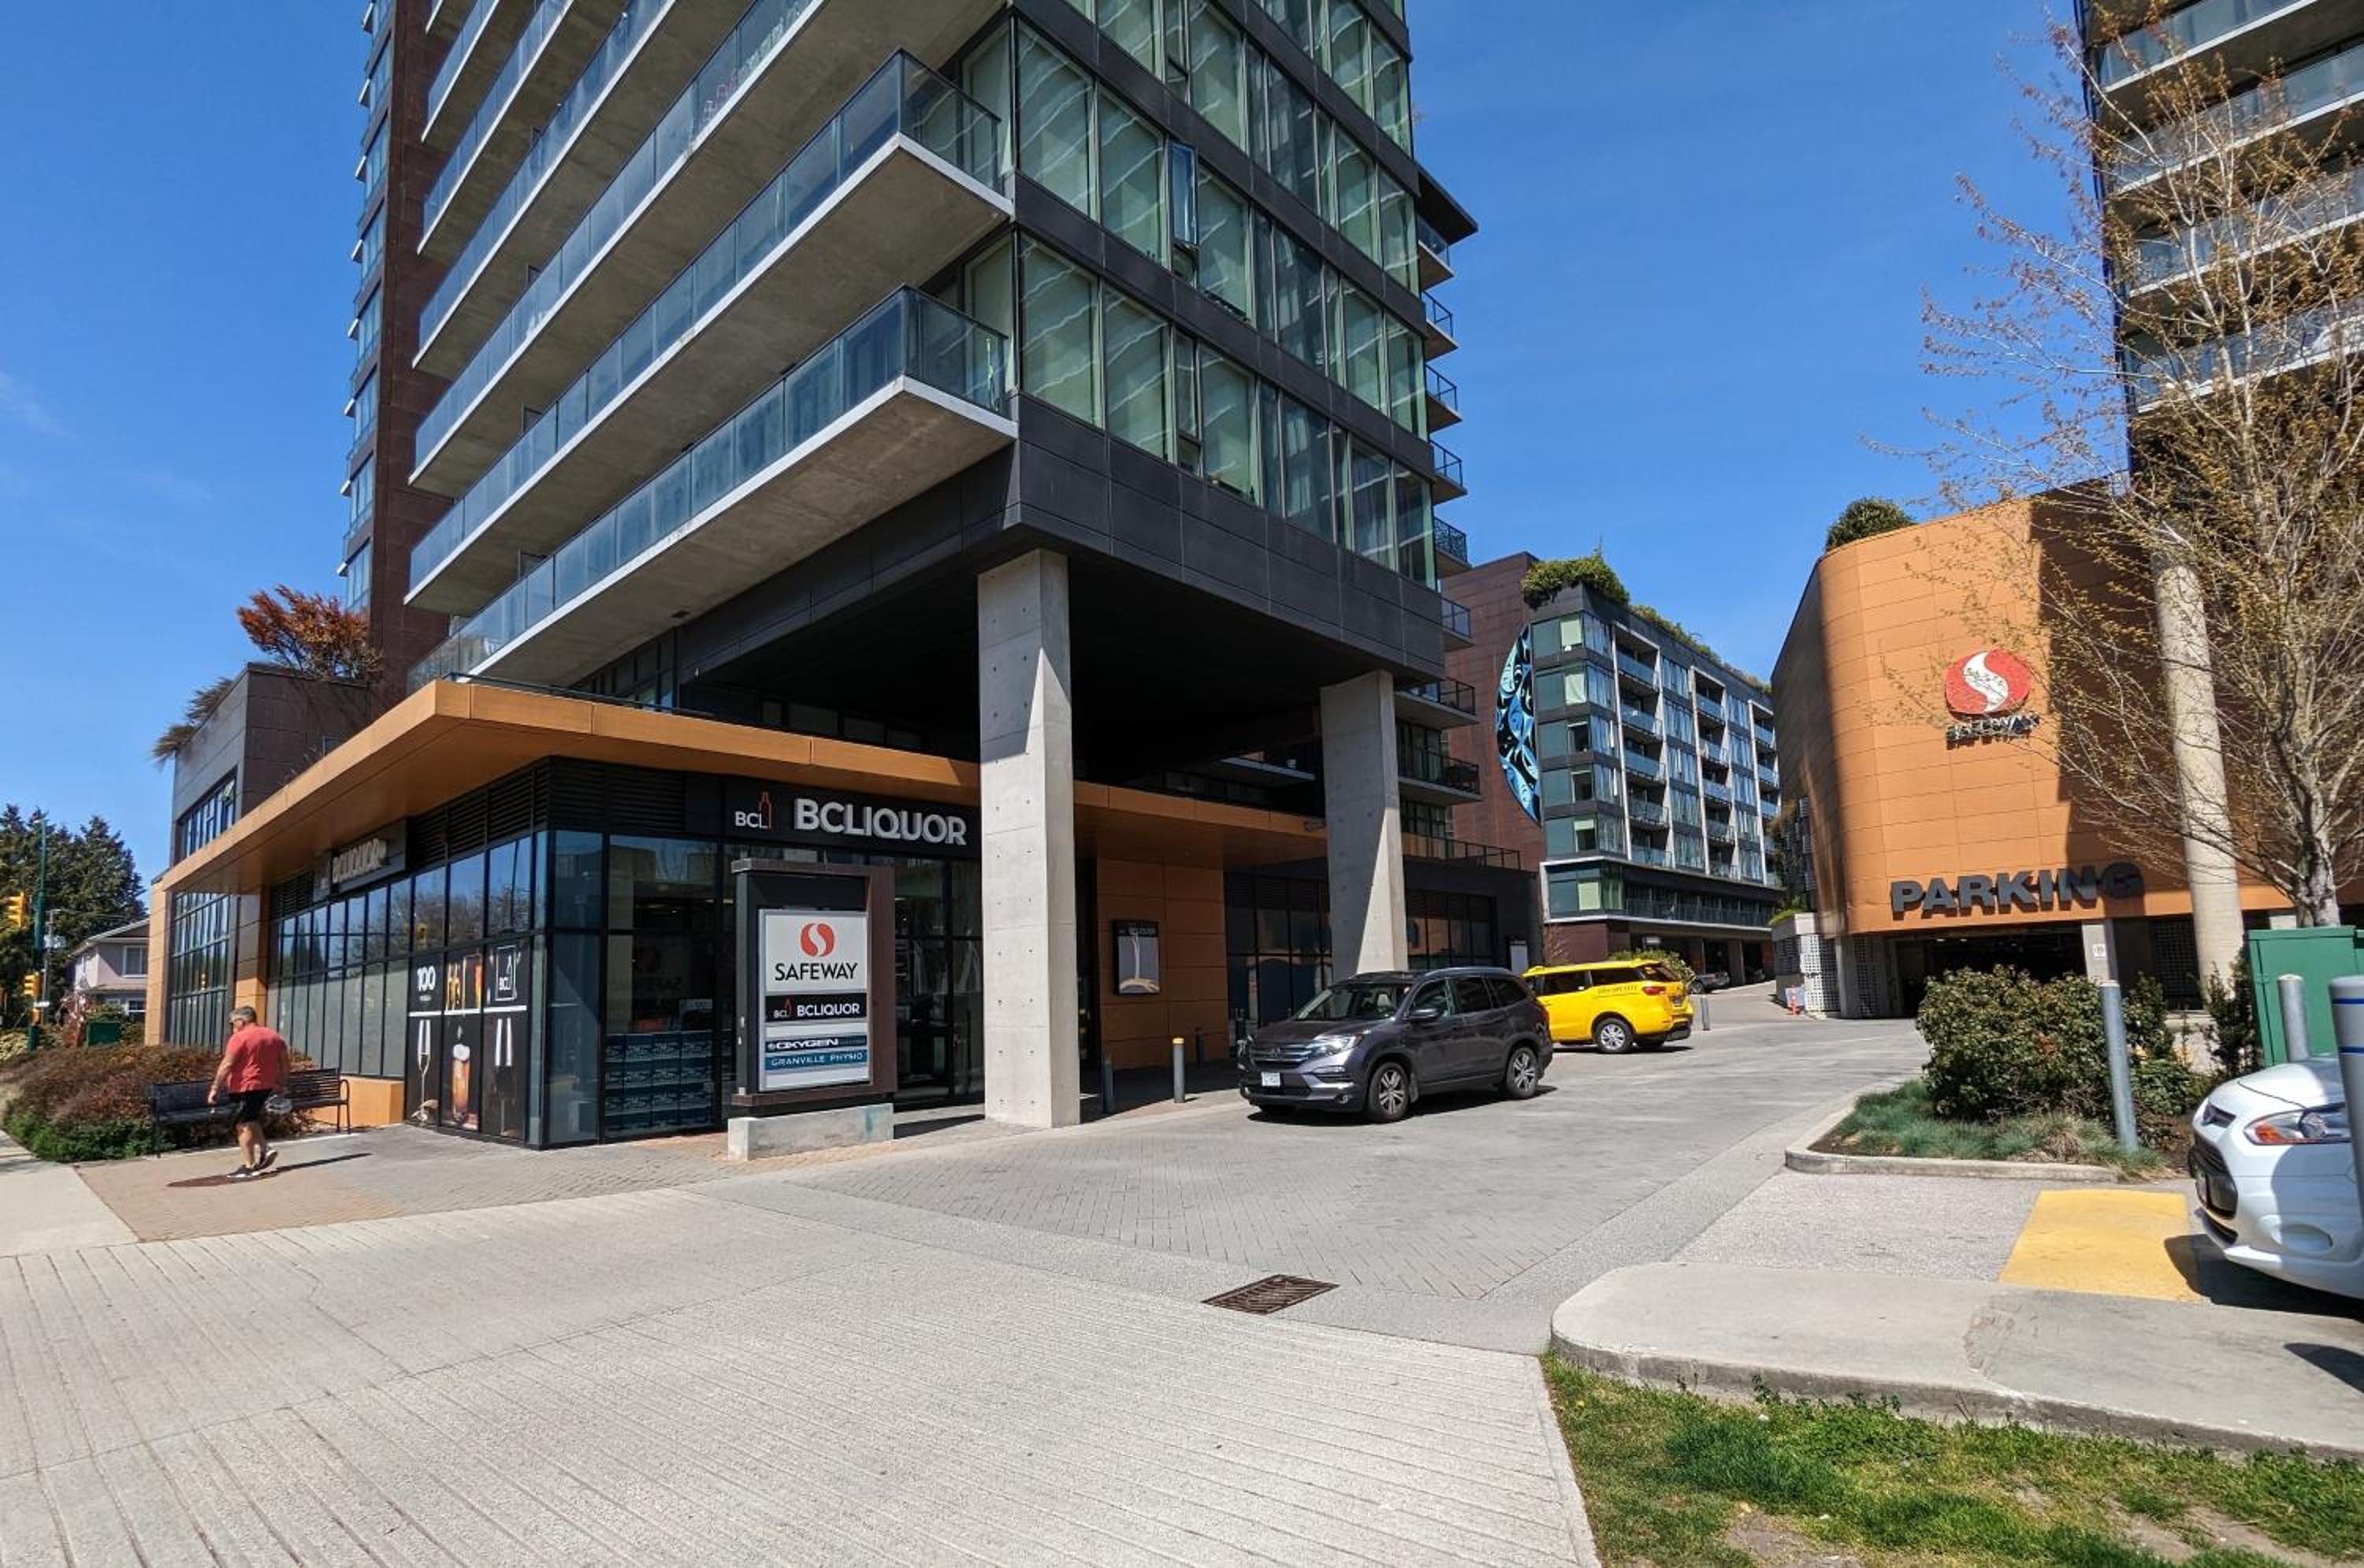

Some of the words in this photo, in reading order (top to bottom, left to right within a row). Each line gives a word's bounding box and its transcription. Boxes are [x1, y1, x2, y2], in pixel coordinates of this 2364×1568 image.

[734, 811, 768, 828] BCL
[794, 797, 968, 845] BCLIQUOR
[1890, 862, 2145, 913] PARKING
[417, 966, 437, 992] 100
[775, 962, 858, 981] SAFEWAY
[797, 1003, 860, 1017] BCLIQUOR
[776, 1038, 838, 1050] OXYGEN
[771, 1055, 825, 1066] GRANVILLE
[830, 1052, 863, 1062] PHYSIO
